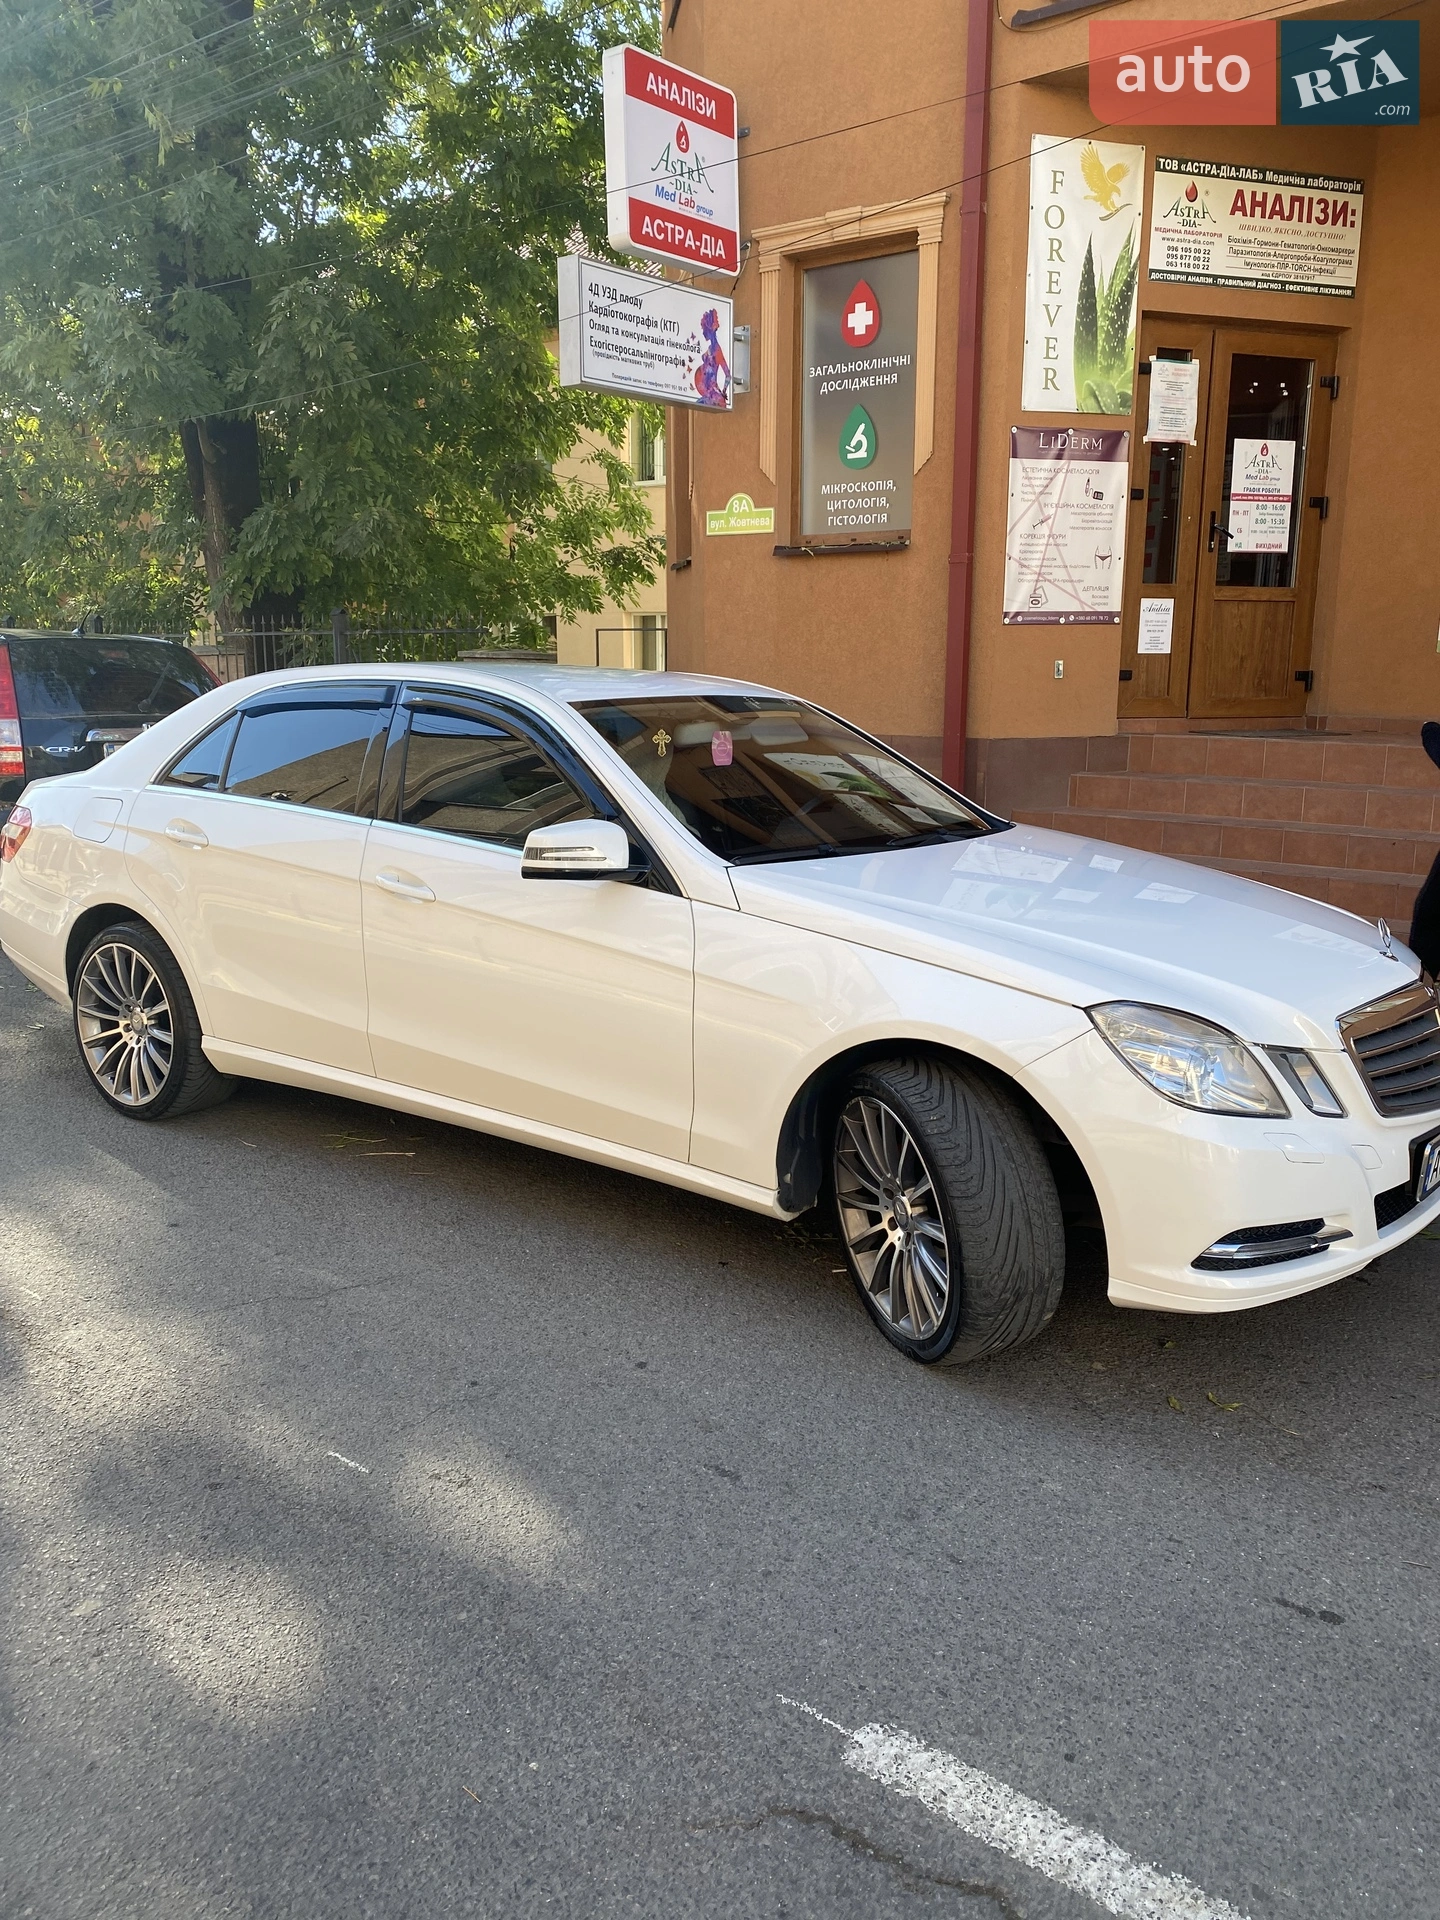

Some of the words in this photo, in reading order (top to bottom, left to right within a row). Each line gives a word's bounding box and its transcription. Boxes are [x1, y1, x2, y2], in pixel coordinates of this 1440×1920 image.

[646, 72, 716, 120] АНАЛІЗИ
[1159, 158, 1178, 171] ТОВ
[1265, 170, 1305, 185] Медична
[1307, 177, 1361, 192] лабораторія
[655, 184, 676, 202] Med
[678, 192, 695, 209] Lab
[696, 204, 713, 217] group
[1229, 188, 1356, 228] АНАЛІЗИ:
[642, 215, 725, 259] АСТРА-ДІА
[1154, 226, 1182, 235] МЕДИЧНА
[1183, 229, 1223, 239] ЛАБОРАТОРІЯ
[1042, 169, 1065, 391] FOREVER
[1150, 272, 1186, 281] ДОСТОВІРНІ
[1187, 275, 1213, 284] АНАЛІЗИ
[1257, 282, 1281, 290] ДІАГНОЗ
[588, 282, 599, 298] 4Д
[602, 285, 617, 302] УЗД
[619, 293, 643, 310] плоду
[588, 300, 659, 330] Кардіотокографія
[660, 317, 679, 336] (КТГ)
[589, 318, 610, 335] Огляд
[611, 326, 619, 336] та
[620, 329, 665, 347] консультація
[666, 337, 701, 354] гінеколога
[809, 354, 911, 378] ЗАГАЛЬНОКЛІНІЧНІ
[820, 373, 898, 395] ДОСЛІДЖЕННЯ
[821, 479, 897, 495] МІКРОСКОПІЯ,
[1245, 473, 1258, 481] Med
[826, 496, 890, 512] ЦИТОЛОГІЯ,
[710, 519, 727, 531] вул.
[728, 516, 770, 528] Жовтнева
[828, 513, 888, 527] ГІСТОЛОГІЯ
